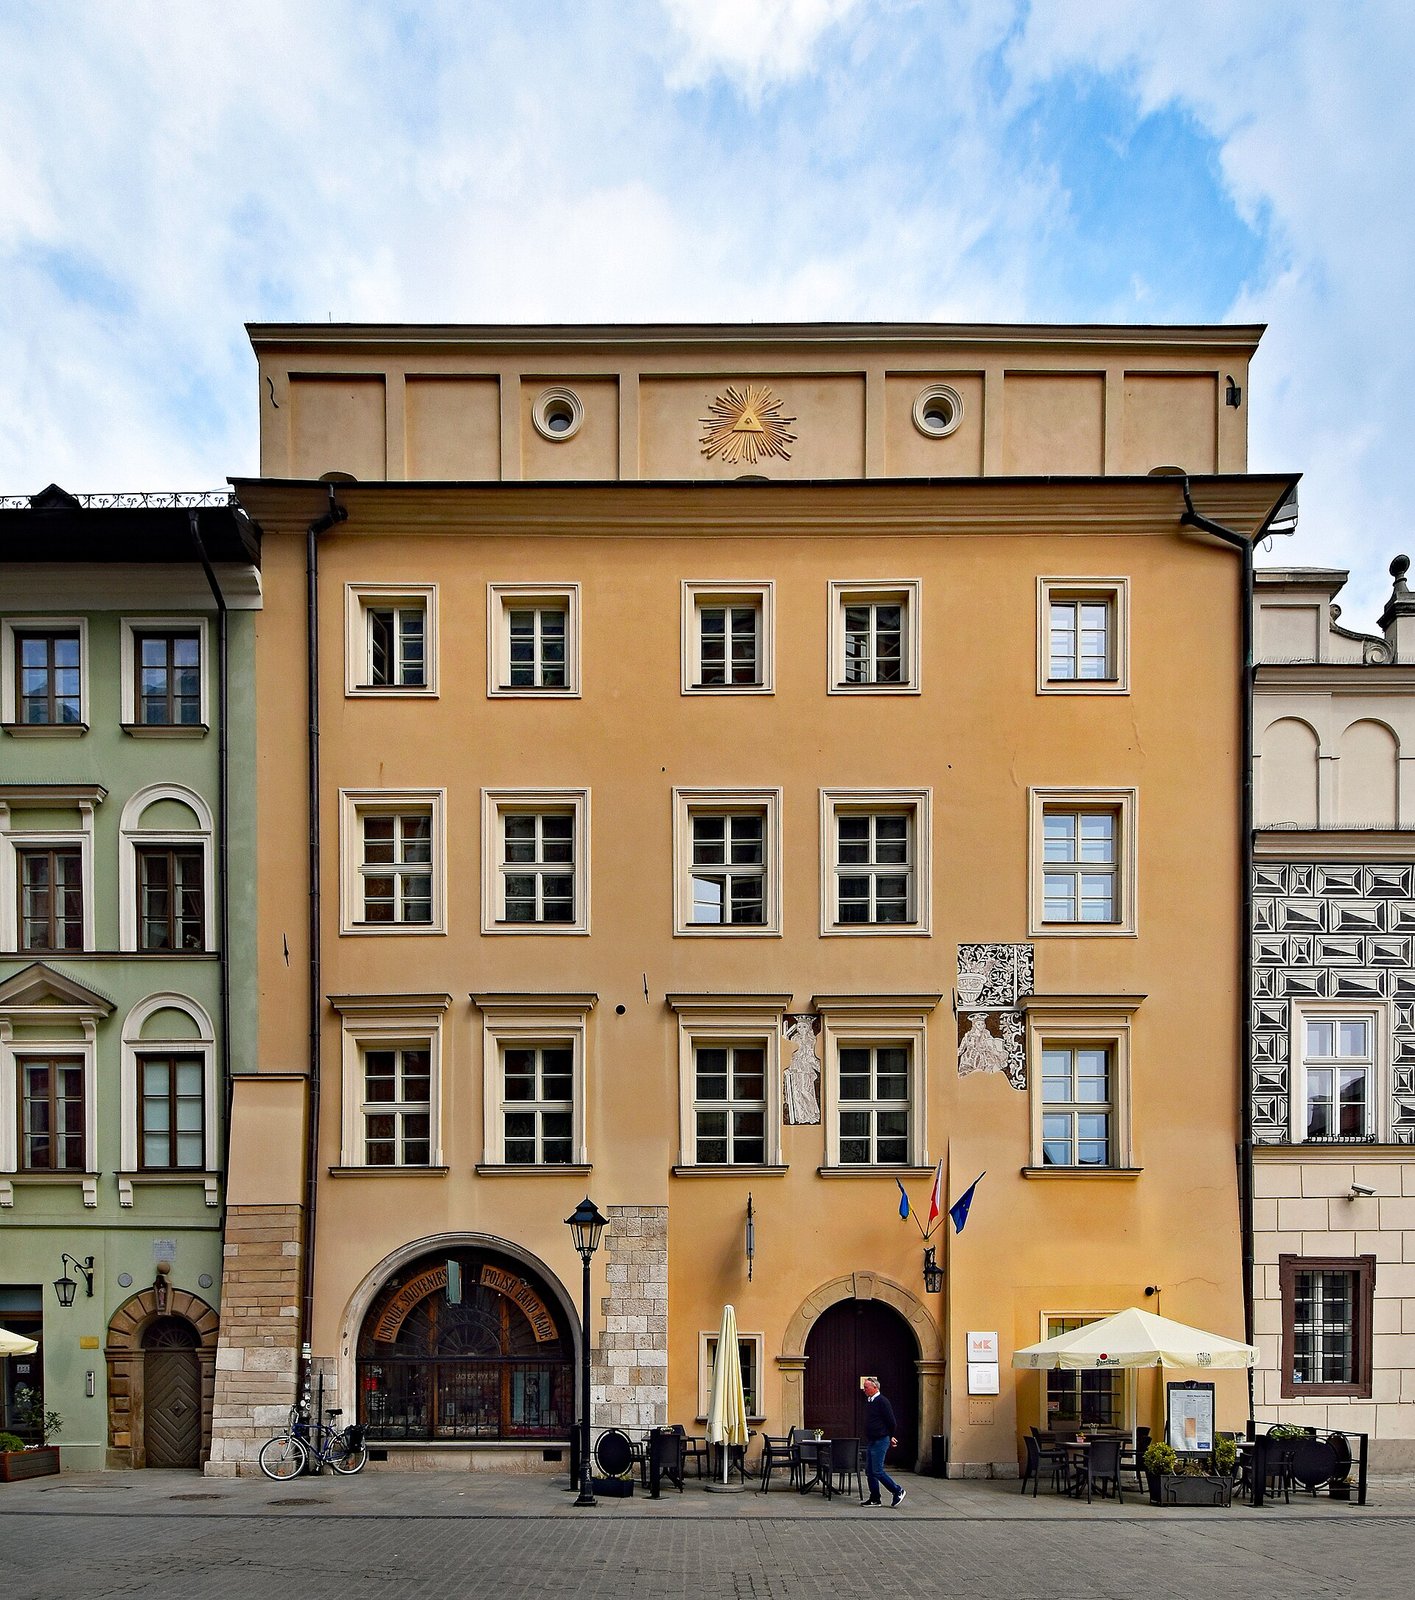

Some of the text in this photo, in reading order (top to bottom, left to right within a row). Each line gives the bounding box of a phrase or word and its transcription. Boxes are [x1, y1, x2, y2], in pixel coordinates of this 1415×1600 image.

[378, 1268, 448, 1340] UNIQUE SOUVENIRS
[483, 1268, 554, 1340] POLISH HAND MADE
[972, 1339, 992, 1350] MK
